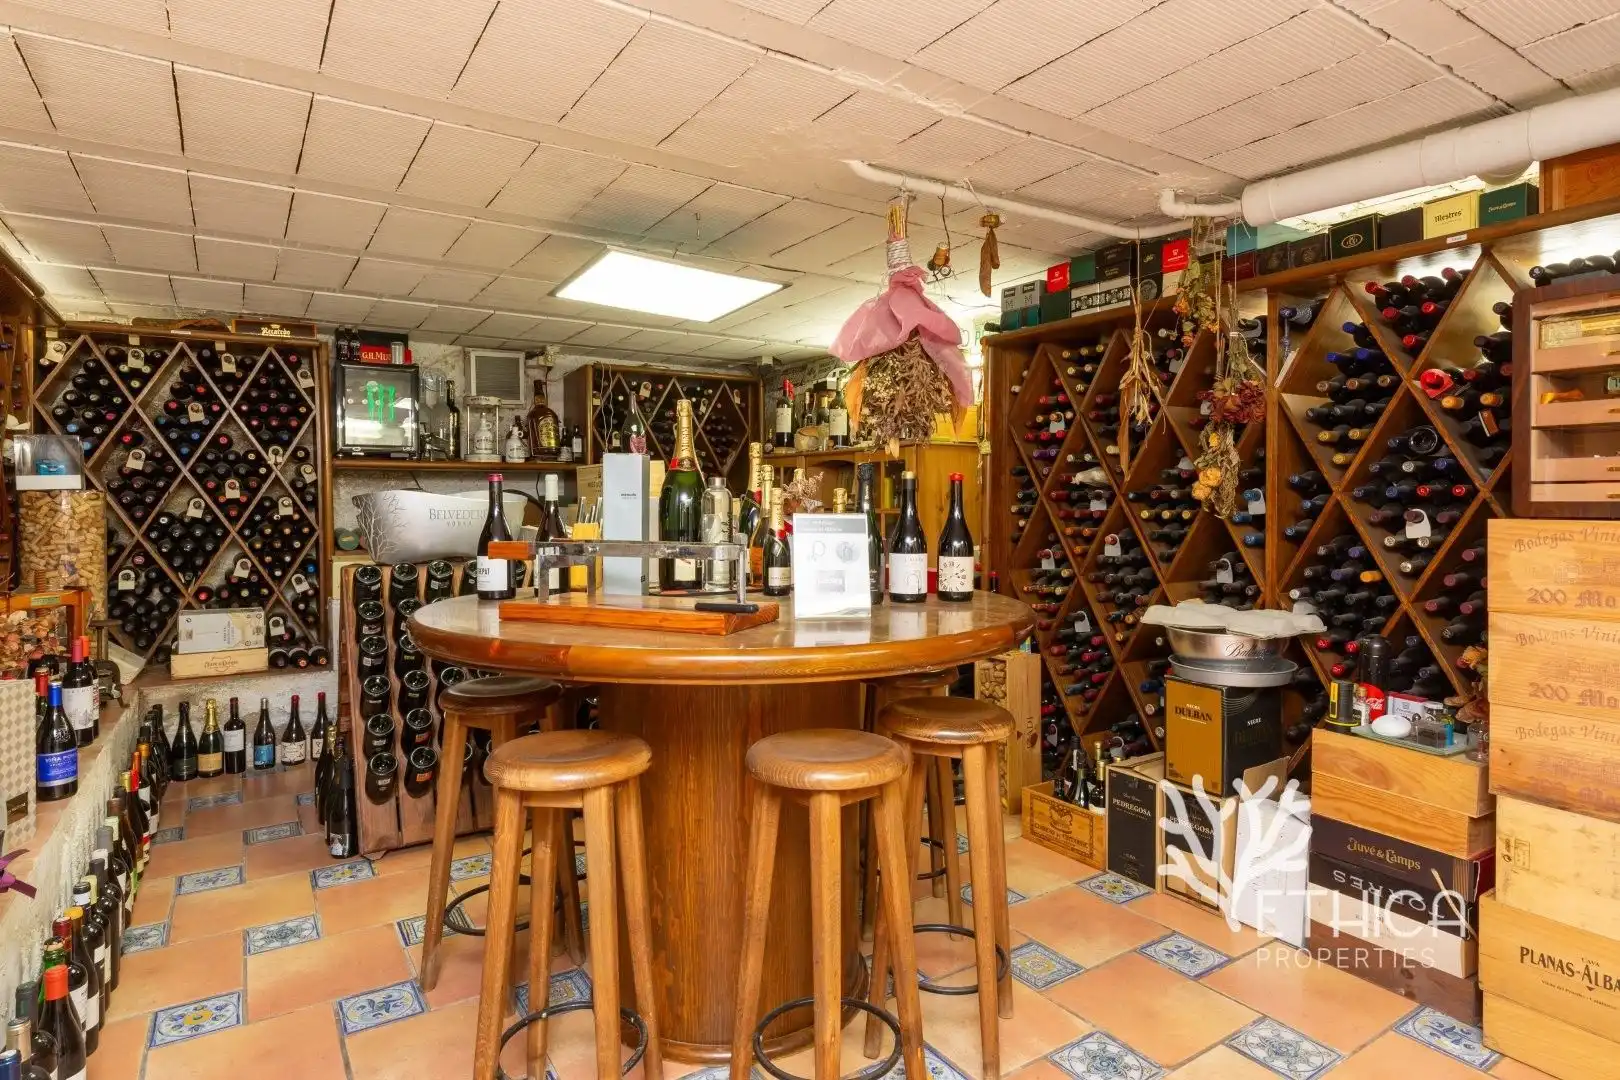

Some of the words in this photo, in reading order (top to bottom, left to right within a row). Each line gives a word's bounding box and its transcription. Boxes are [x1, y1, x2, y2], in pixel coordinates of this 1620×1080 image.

[1434, 210, 1462, 223] Mestres
[1514, 529, 1575, 553] Bodegas
[1527, 587, 1567, 606] 200
[1515, 627, 1576, 647] Bodegas
[1528, 681, 1570, 703] 200
[1174, 706, 1212, 722] DULBAN
[1515, 722, 1575, 741] Bodegas
[1112, 798, 1151, 817] PEDREGOSA
[1346, 837, 1376, 856] Juvé
[1376, 849, 1385, 859] &
[1385, 849, 1422, 870] Camps
